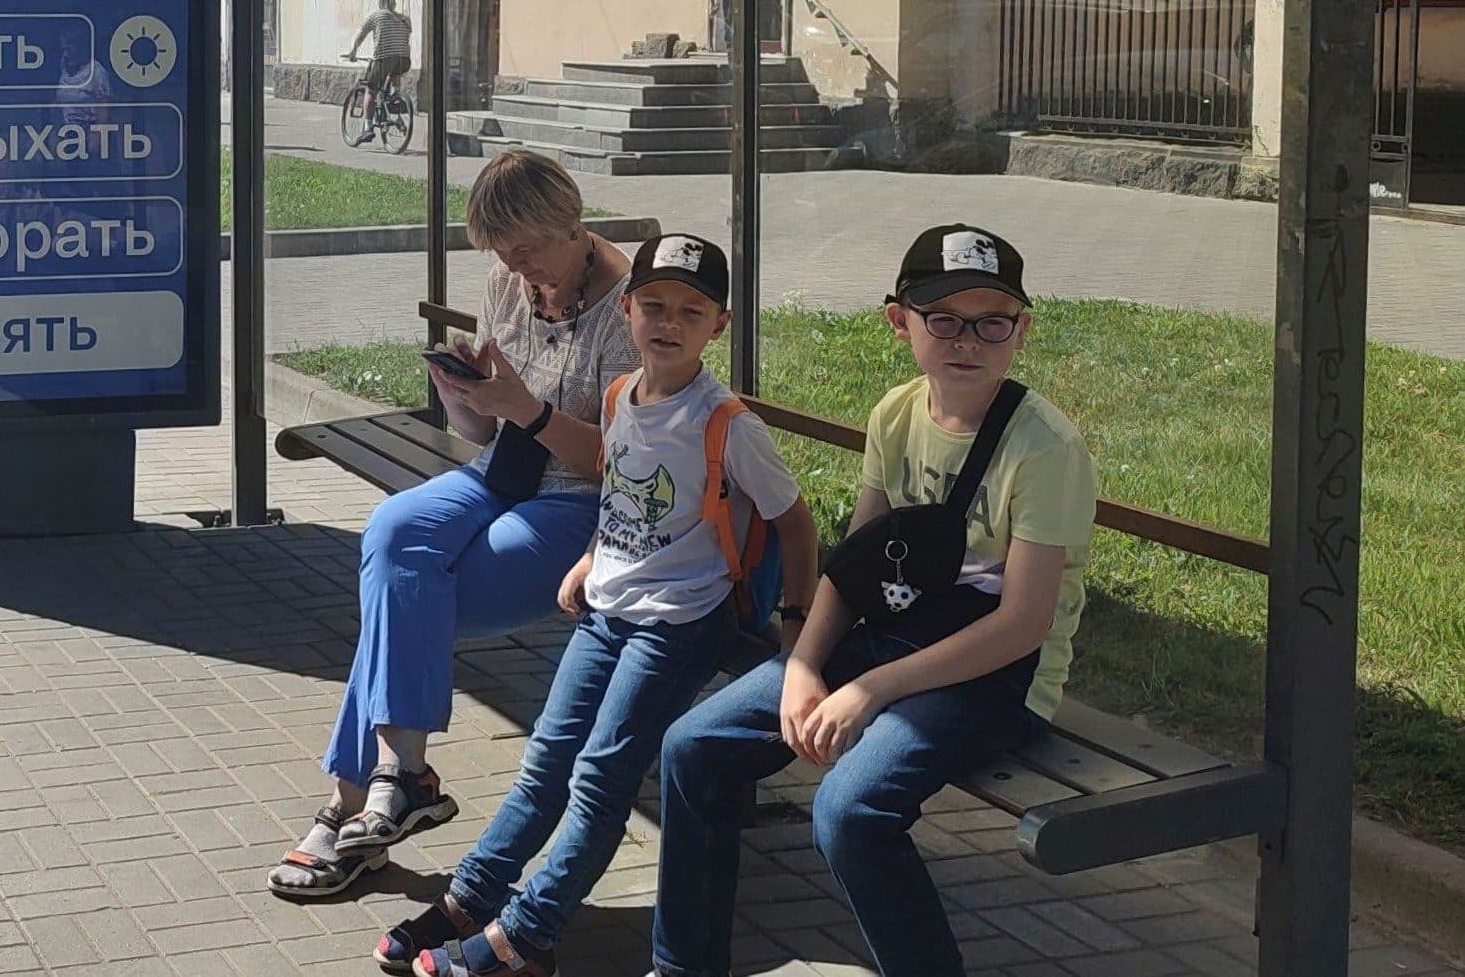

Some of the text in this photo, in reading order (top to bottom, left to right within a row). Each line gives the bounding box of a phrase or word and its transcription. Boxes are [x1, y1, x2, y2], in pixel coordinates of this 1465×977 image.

[604, 516, 672, 552] TO MY NEW
